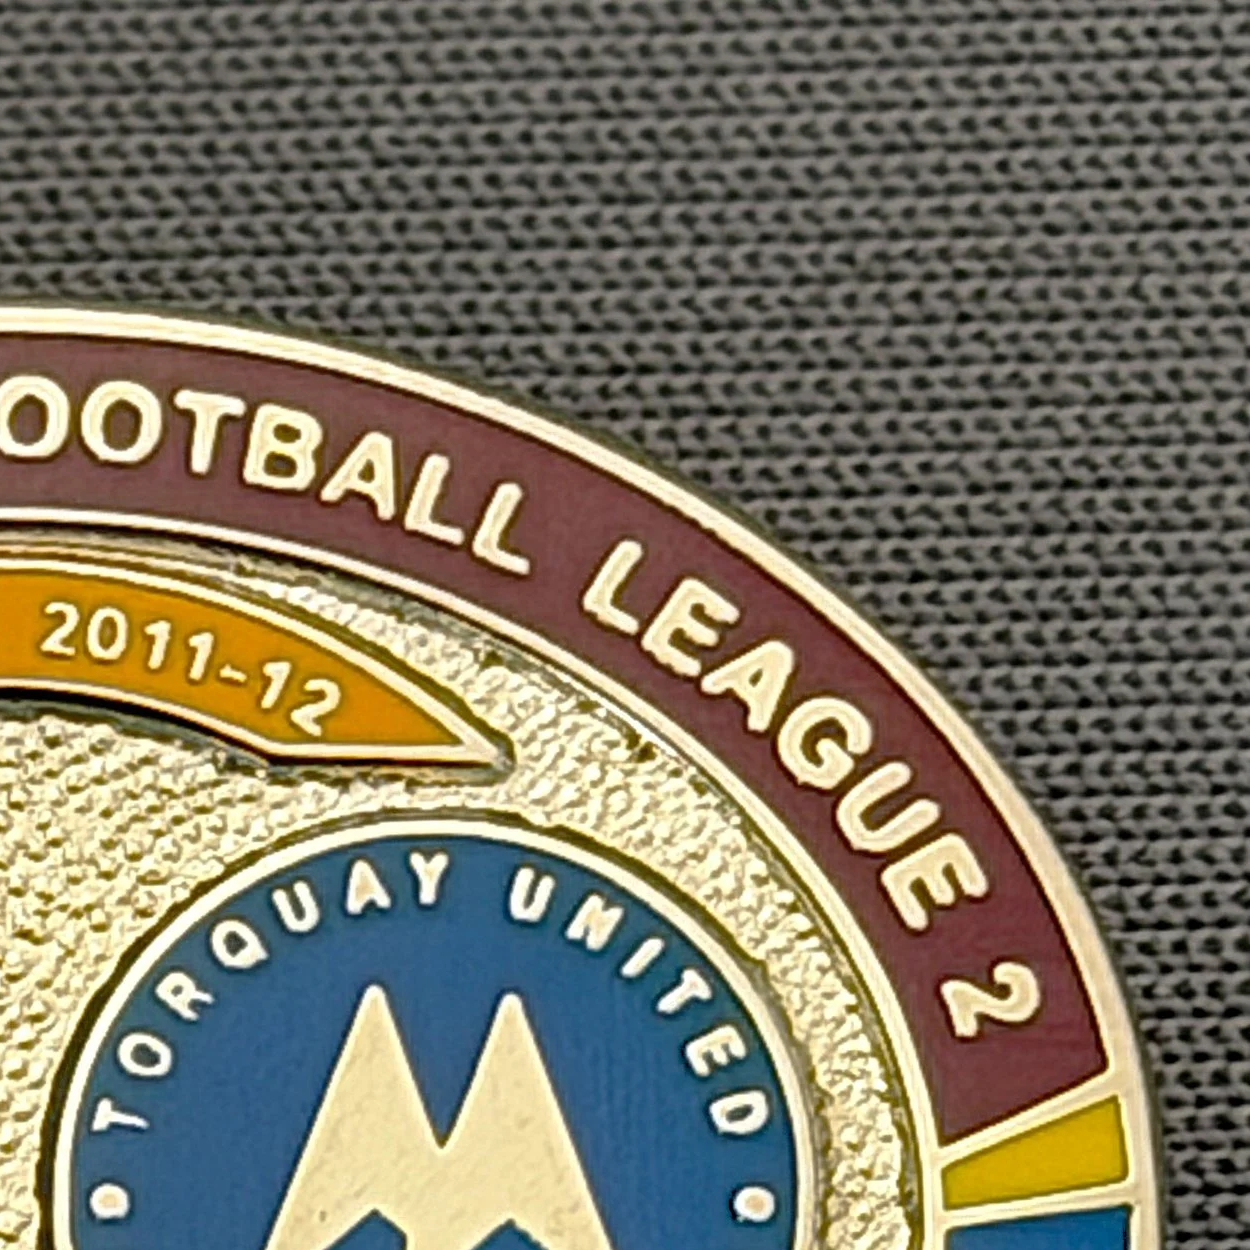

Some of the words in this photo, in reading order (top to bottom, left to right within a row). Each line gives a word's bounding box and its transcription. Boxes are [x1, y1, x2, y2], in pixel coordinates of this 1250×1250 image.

[41, 600, 344, 735] 2011-12
[582, 541, 992, 932] LEAGUE
[943, 963, 1041, 1038] 2
[92, 852, 448, 1134] TORQUAY
[509, 867, 769, 1135] UNITED
